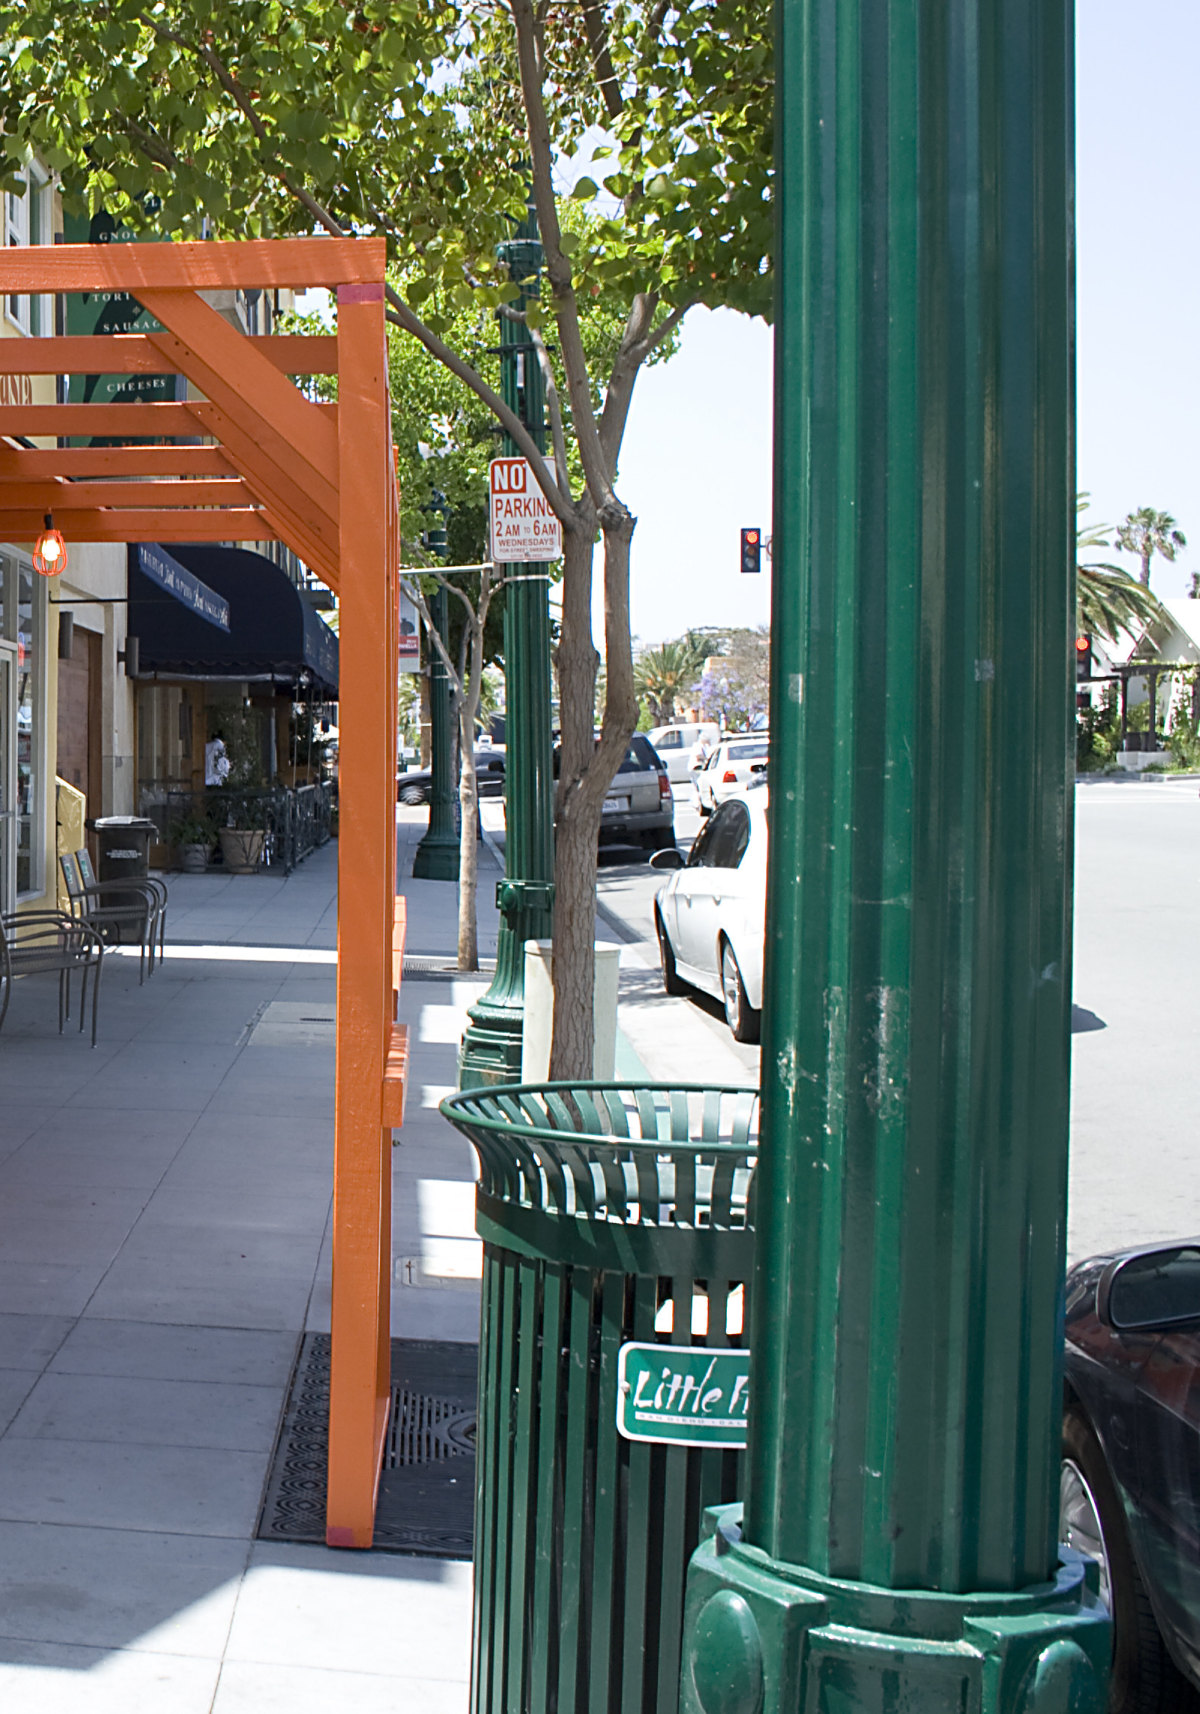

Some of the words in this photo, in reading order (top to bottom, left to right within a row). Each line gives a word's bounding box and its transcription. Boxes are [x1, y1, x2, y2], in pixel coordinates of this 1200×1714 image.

[107, 379, 167, 393] CHEESES
[494, 464, 524, 491] NO
[495, 521, 502, 537] 2
[505, 525, 520, 536] AM
[533, 520, 540, 536] 6
[542, 524, 557, 535] AM
[498, 538, 555, 547] WEDNESDAYS
[633, 1357, 723, 1414] Little
